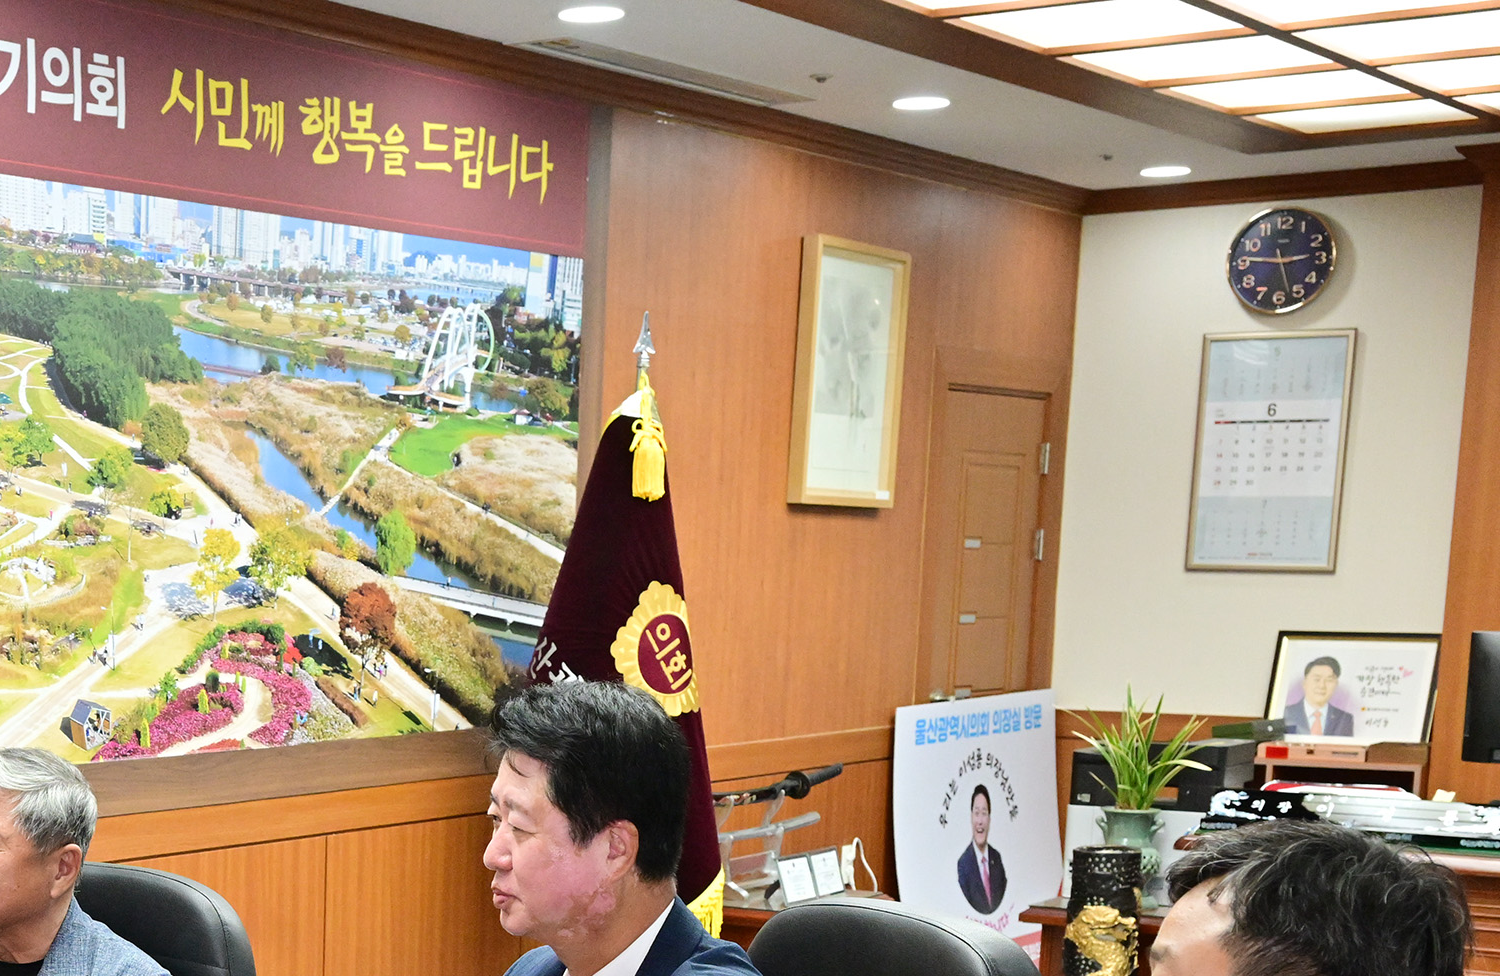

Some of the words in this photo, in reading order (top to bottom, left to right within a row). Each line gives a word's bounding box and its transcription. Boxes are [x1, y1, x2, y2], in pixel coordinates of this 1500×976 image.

[160, 68, 285, 158] 시민께
[298, 96, 410, 177] 행복을
[414, 121, 554, 205] 드립니다
[1260, 222, 1271, 236] 11
[1277, 216, 1294, 230] 12
[1301, 221, 1306, 233] 1
[1245, 238, 1261, 252] 10
[1310, 234, 1323, 248] 2
[1237, 256, 1250, 270] 9
[1315, 251, 1327, 264] 3
[1242, 274, 1255, 288] 8
[1304, 271, 1316, 284] 4
[1256, 286, 1268, 300] 7
[1272, 291, 1286, 304] 6
[1292, 284, 1304, 298] 5
[1267, 403, 1278, 417] 6
[914, 711, 990, 746] 울산광역시의회
[992, 707, 1022, 735] 의장실
[1024, 703, 1042, 730] 방문
